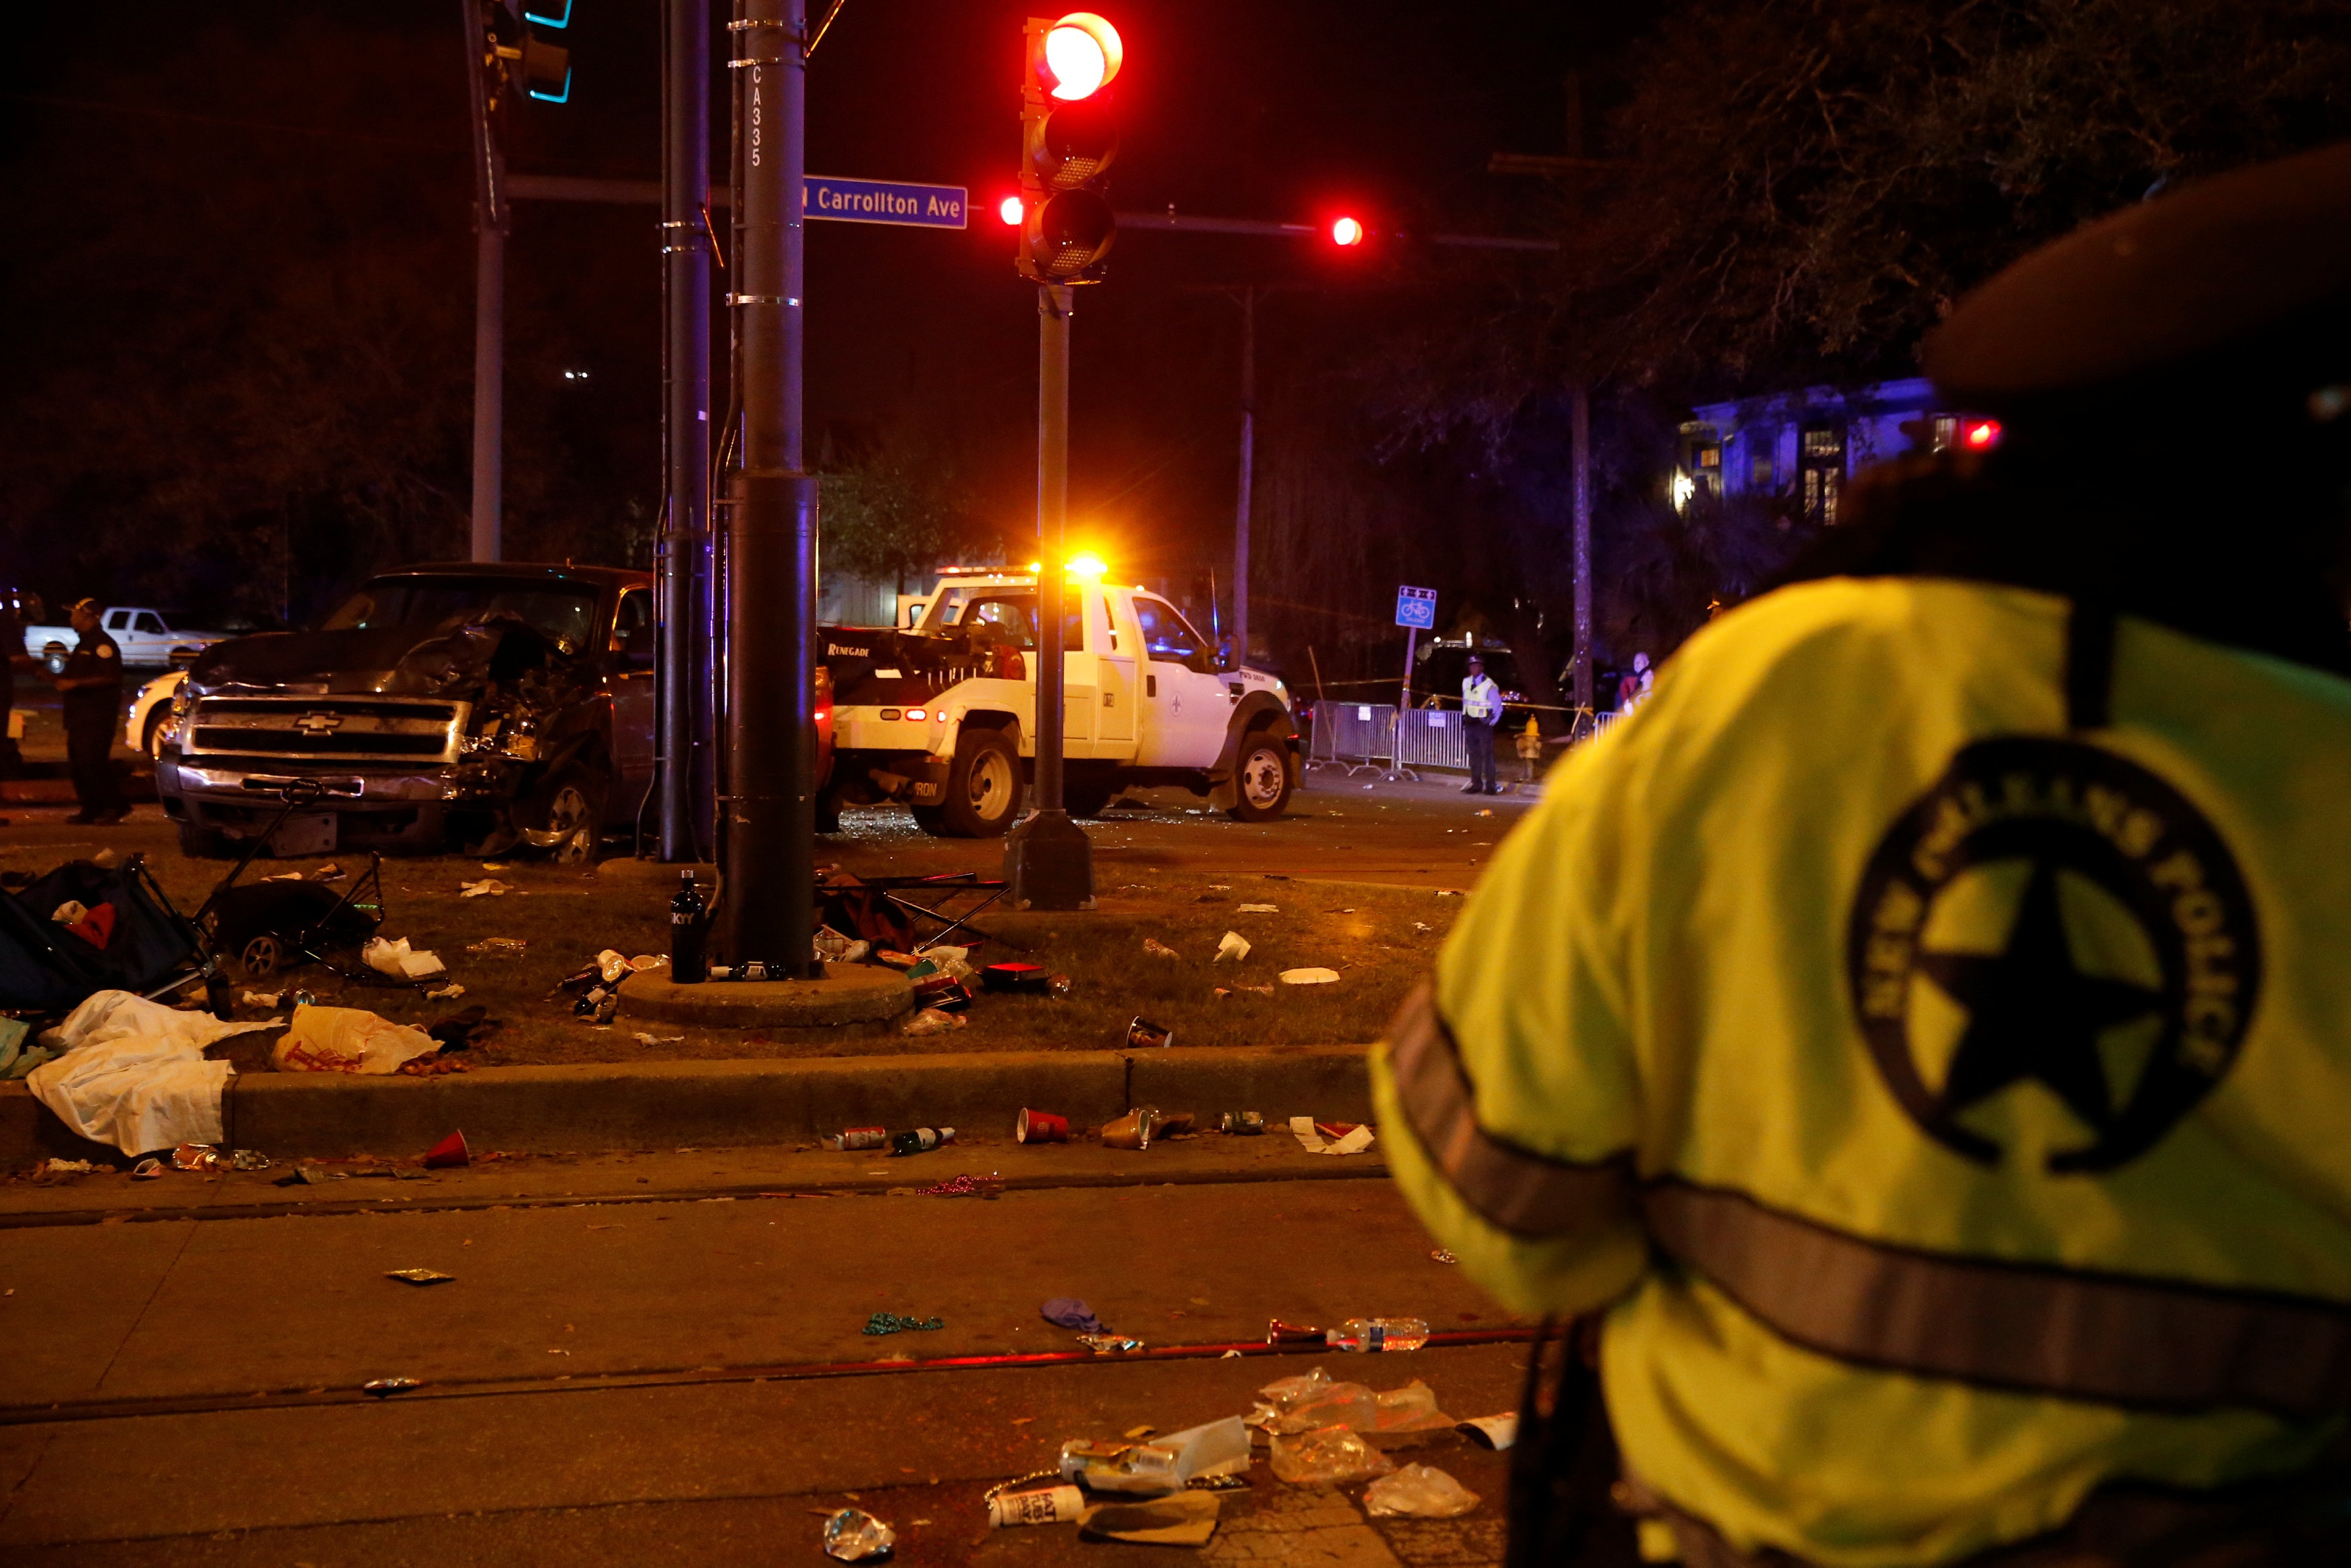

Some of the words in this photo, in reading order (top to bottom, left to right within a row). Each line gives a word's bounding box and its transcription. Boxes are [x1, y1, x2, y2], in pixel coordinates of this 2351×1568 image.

[752, 65, 762, 167] CA335
[818, 187, 918, 215] Carrollton
[927, 195, 961, 218] Ave
[2147, 845, 2242, 1076] POLICE
